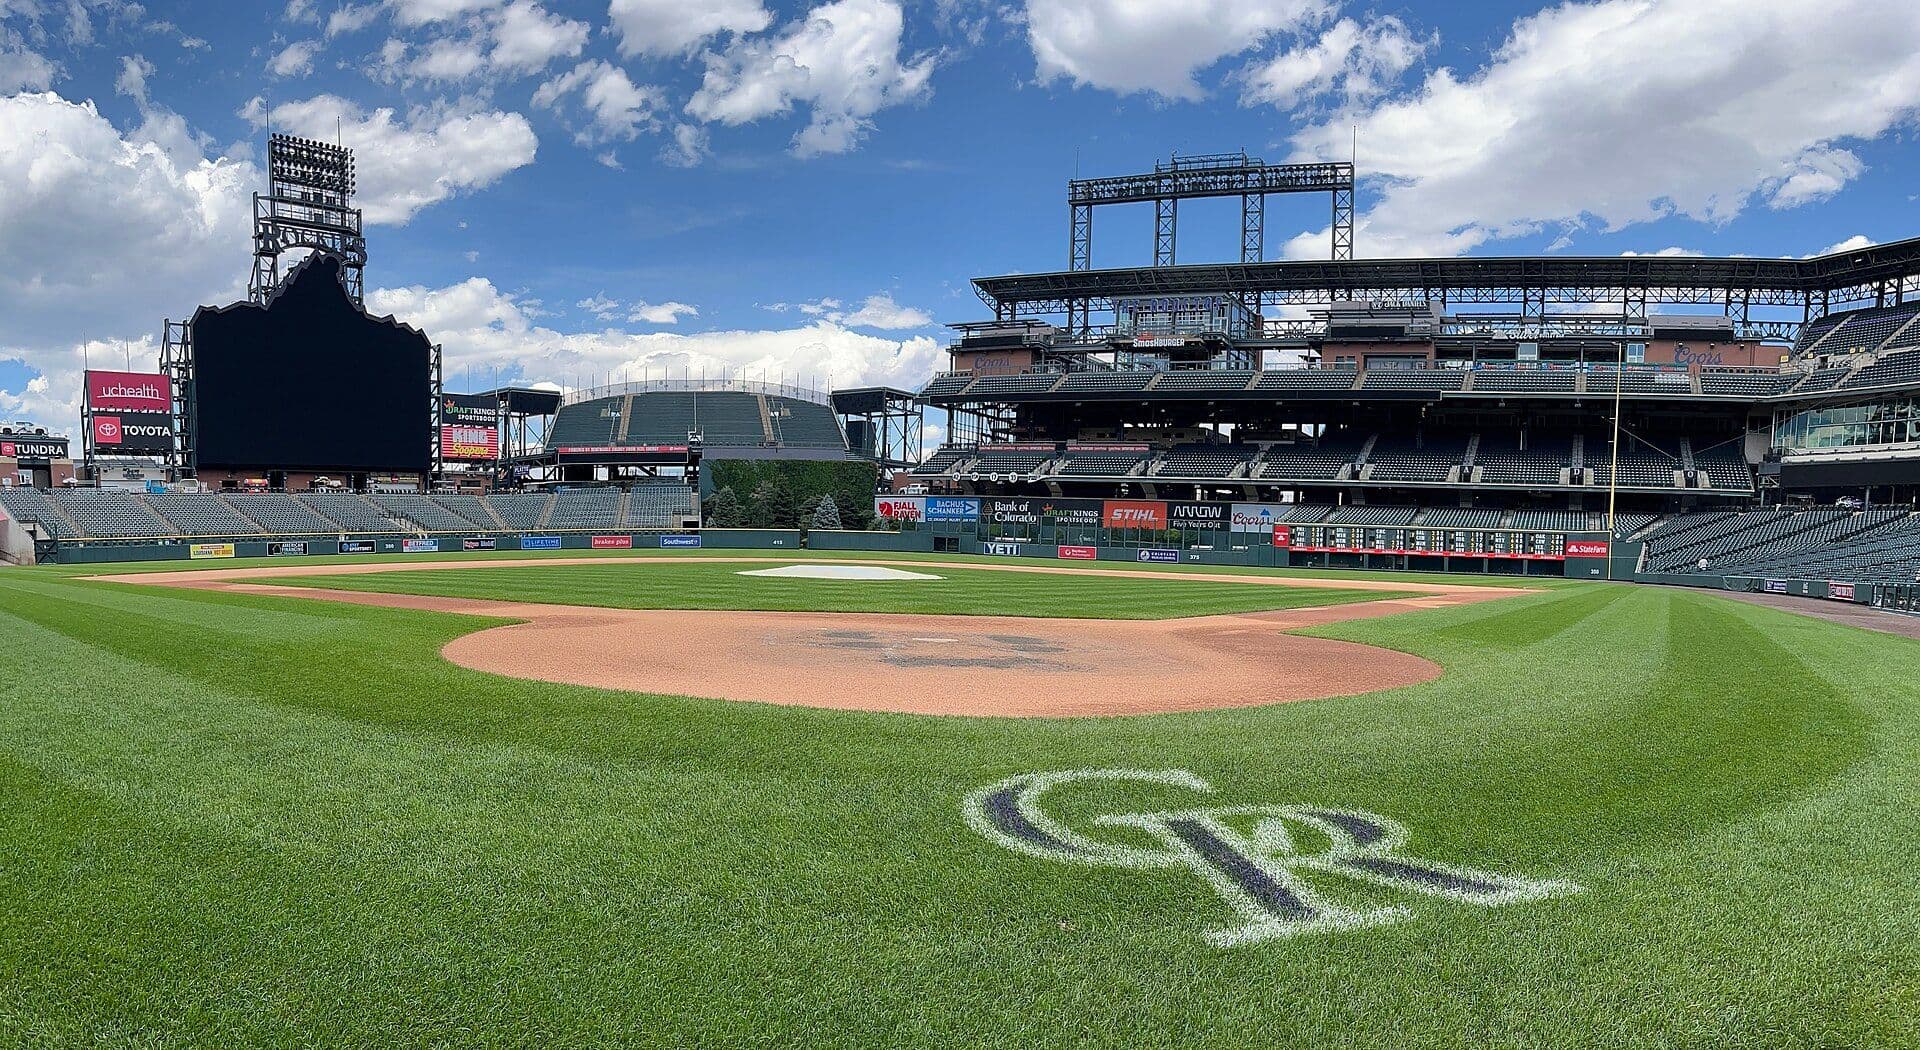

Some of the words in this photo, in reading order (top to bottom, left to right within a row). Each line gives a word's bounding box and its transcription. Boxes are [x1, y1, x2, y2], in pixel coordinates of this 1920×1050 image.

[974, 356, 1010, 369] Coors
[1674, 347, 1723, 367] Coors
[102, 383, 160, 398] uchealth
[445, 406, 496, 416] DRAFTKINGS
[457, 414, 496, 422] SPORTSBOOK
[122, 425, 171, 437] TOYOTA
[453, 428, 488, 444] KING
[15, 444, 64, 455] TUNDRA
[453, 443, 489, 456] Soopers
[995, 502, 1018, 511] Bank
[1019, 501, 1030, 511] of
[1174, 506, 1222, 518] ARROW
[894, 510, 921, 518] RAVEN
[995, 511, 1036, 522] Colorado
[1112, 509, 1158, 521] STIHL
[1233, 512, 1264, 525] Coors
[987, 544, 1017, 554] YETI
